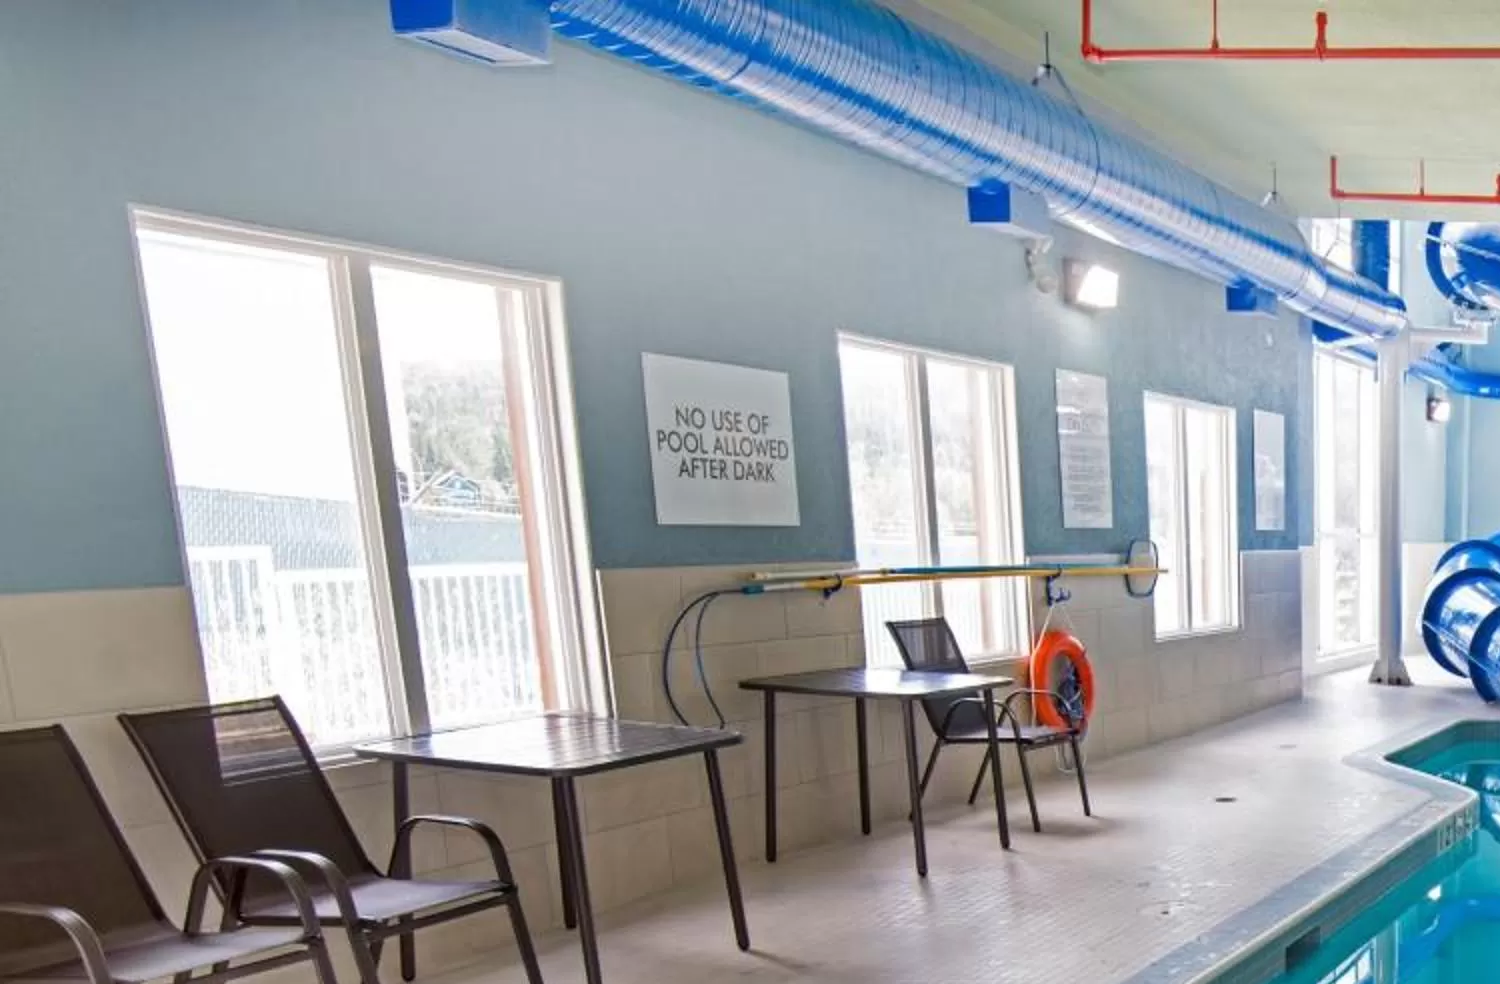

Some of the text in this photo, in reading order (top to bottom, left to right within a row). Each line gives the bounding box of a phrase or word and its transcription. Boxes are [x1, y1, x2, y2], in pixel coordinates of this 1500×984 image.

[675, 405, 769, 434] NO USE OF
[656, 430, 788, 460] POOL ALLOWED
[678, 458, 776, 481] AFTER DARK
